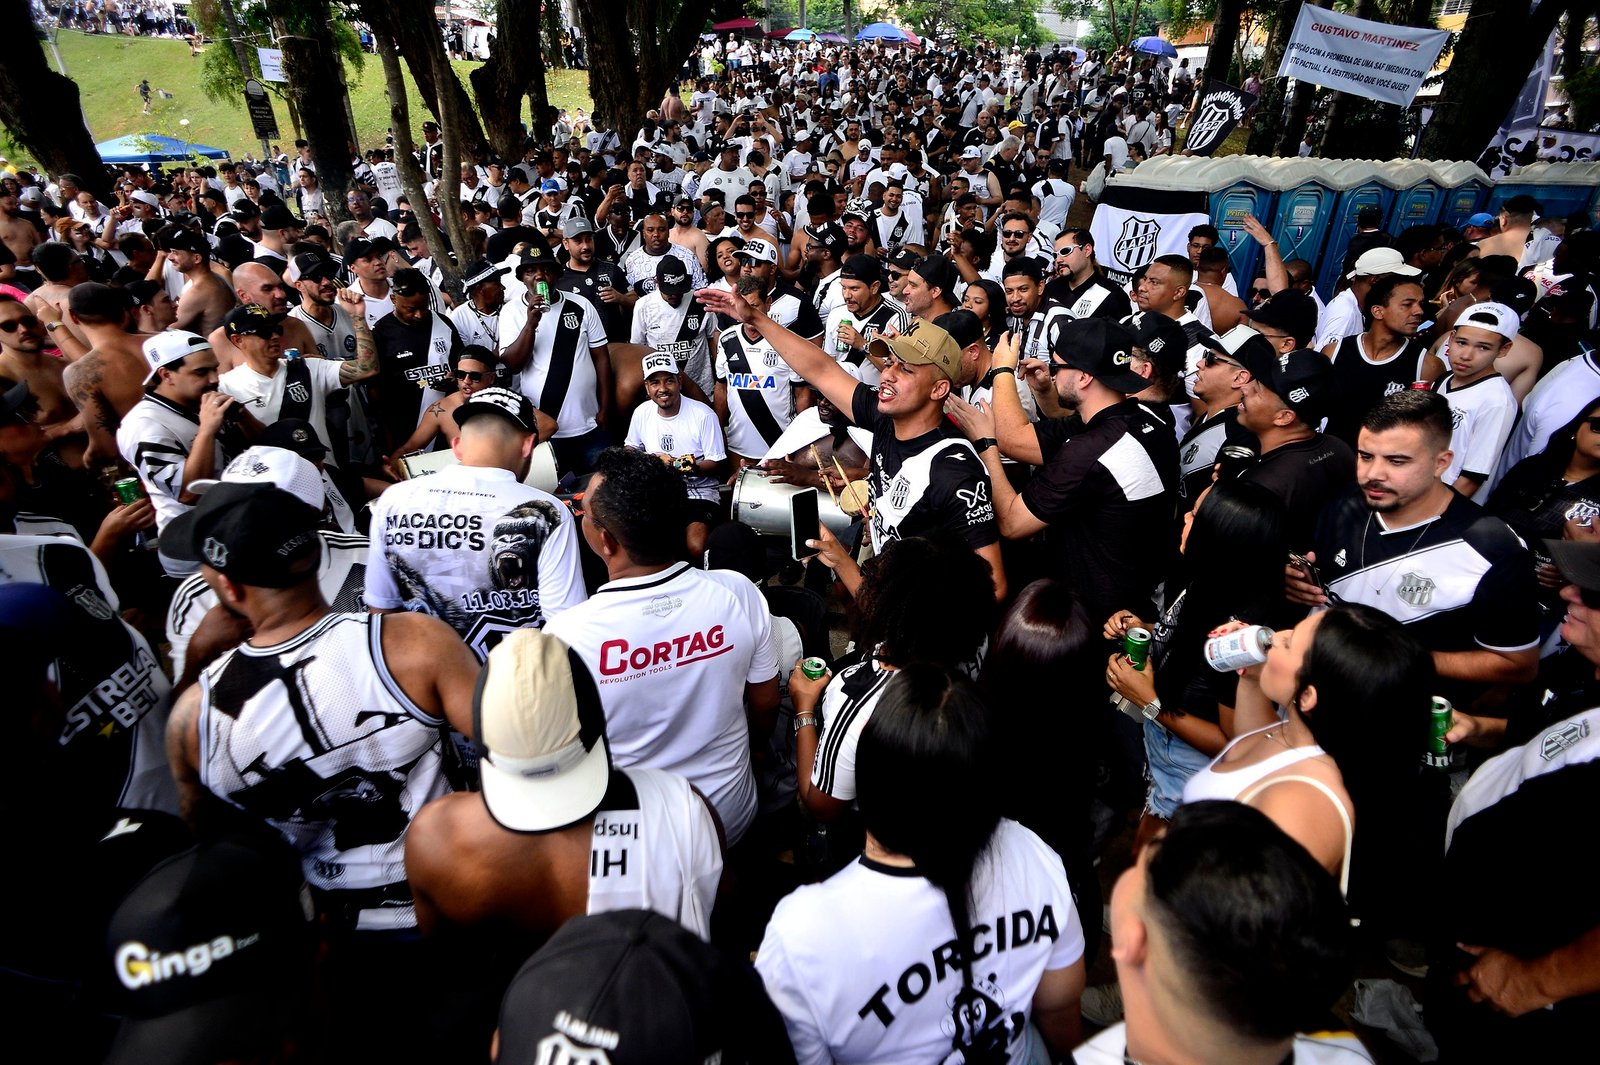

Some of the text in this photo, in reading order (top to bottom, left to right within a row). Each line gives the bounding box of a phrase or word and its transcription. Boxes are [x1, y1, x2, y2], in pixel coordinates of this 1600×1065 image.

[1311, 22, 1420, 52] GUSTAVO MARTINEZ
[1352, 57, 1362, 66] DE
[1361, 59, 1374, 68] UMA
[656, 340, 697, 353] ESTRELA
[673, 350, 692, 361] BET
[405, 363, 450, 380] ESTRELA
[646, 357, 671, 370] DIC'S
[728, 374, 776, 389] CAIXA
[386, 513, 483, 531] MACACOS
[386, 530, 486, 551] DOS DIC'S
[600, 625, 724, 676] CORTAG
[600, 664, 673, 685] REVOLUTION TOOLS
[109, 671, 160, 729] BET
[115, 935, 234, 990] Ginga
[858, 904, 1060, 1029] TORCIDA
